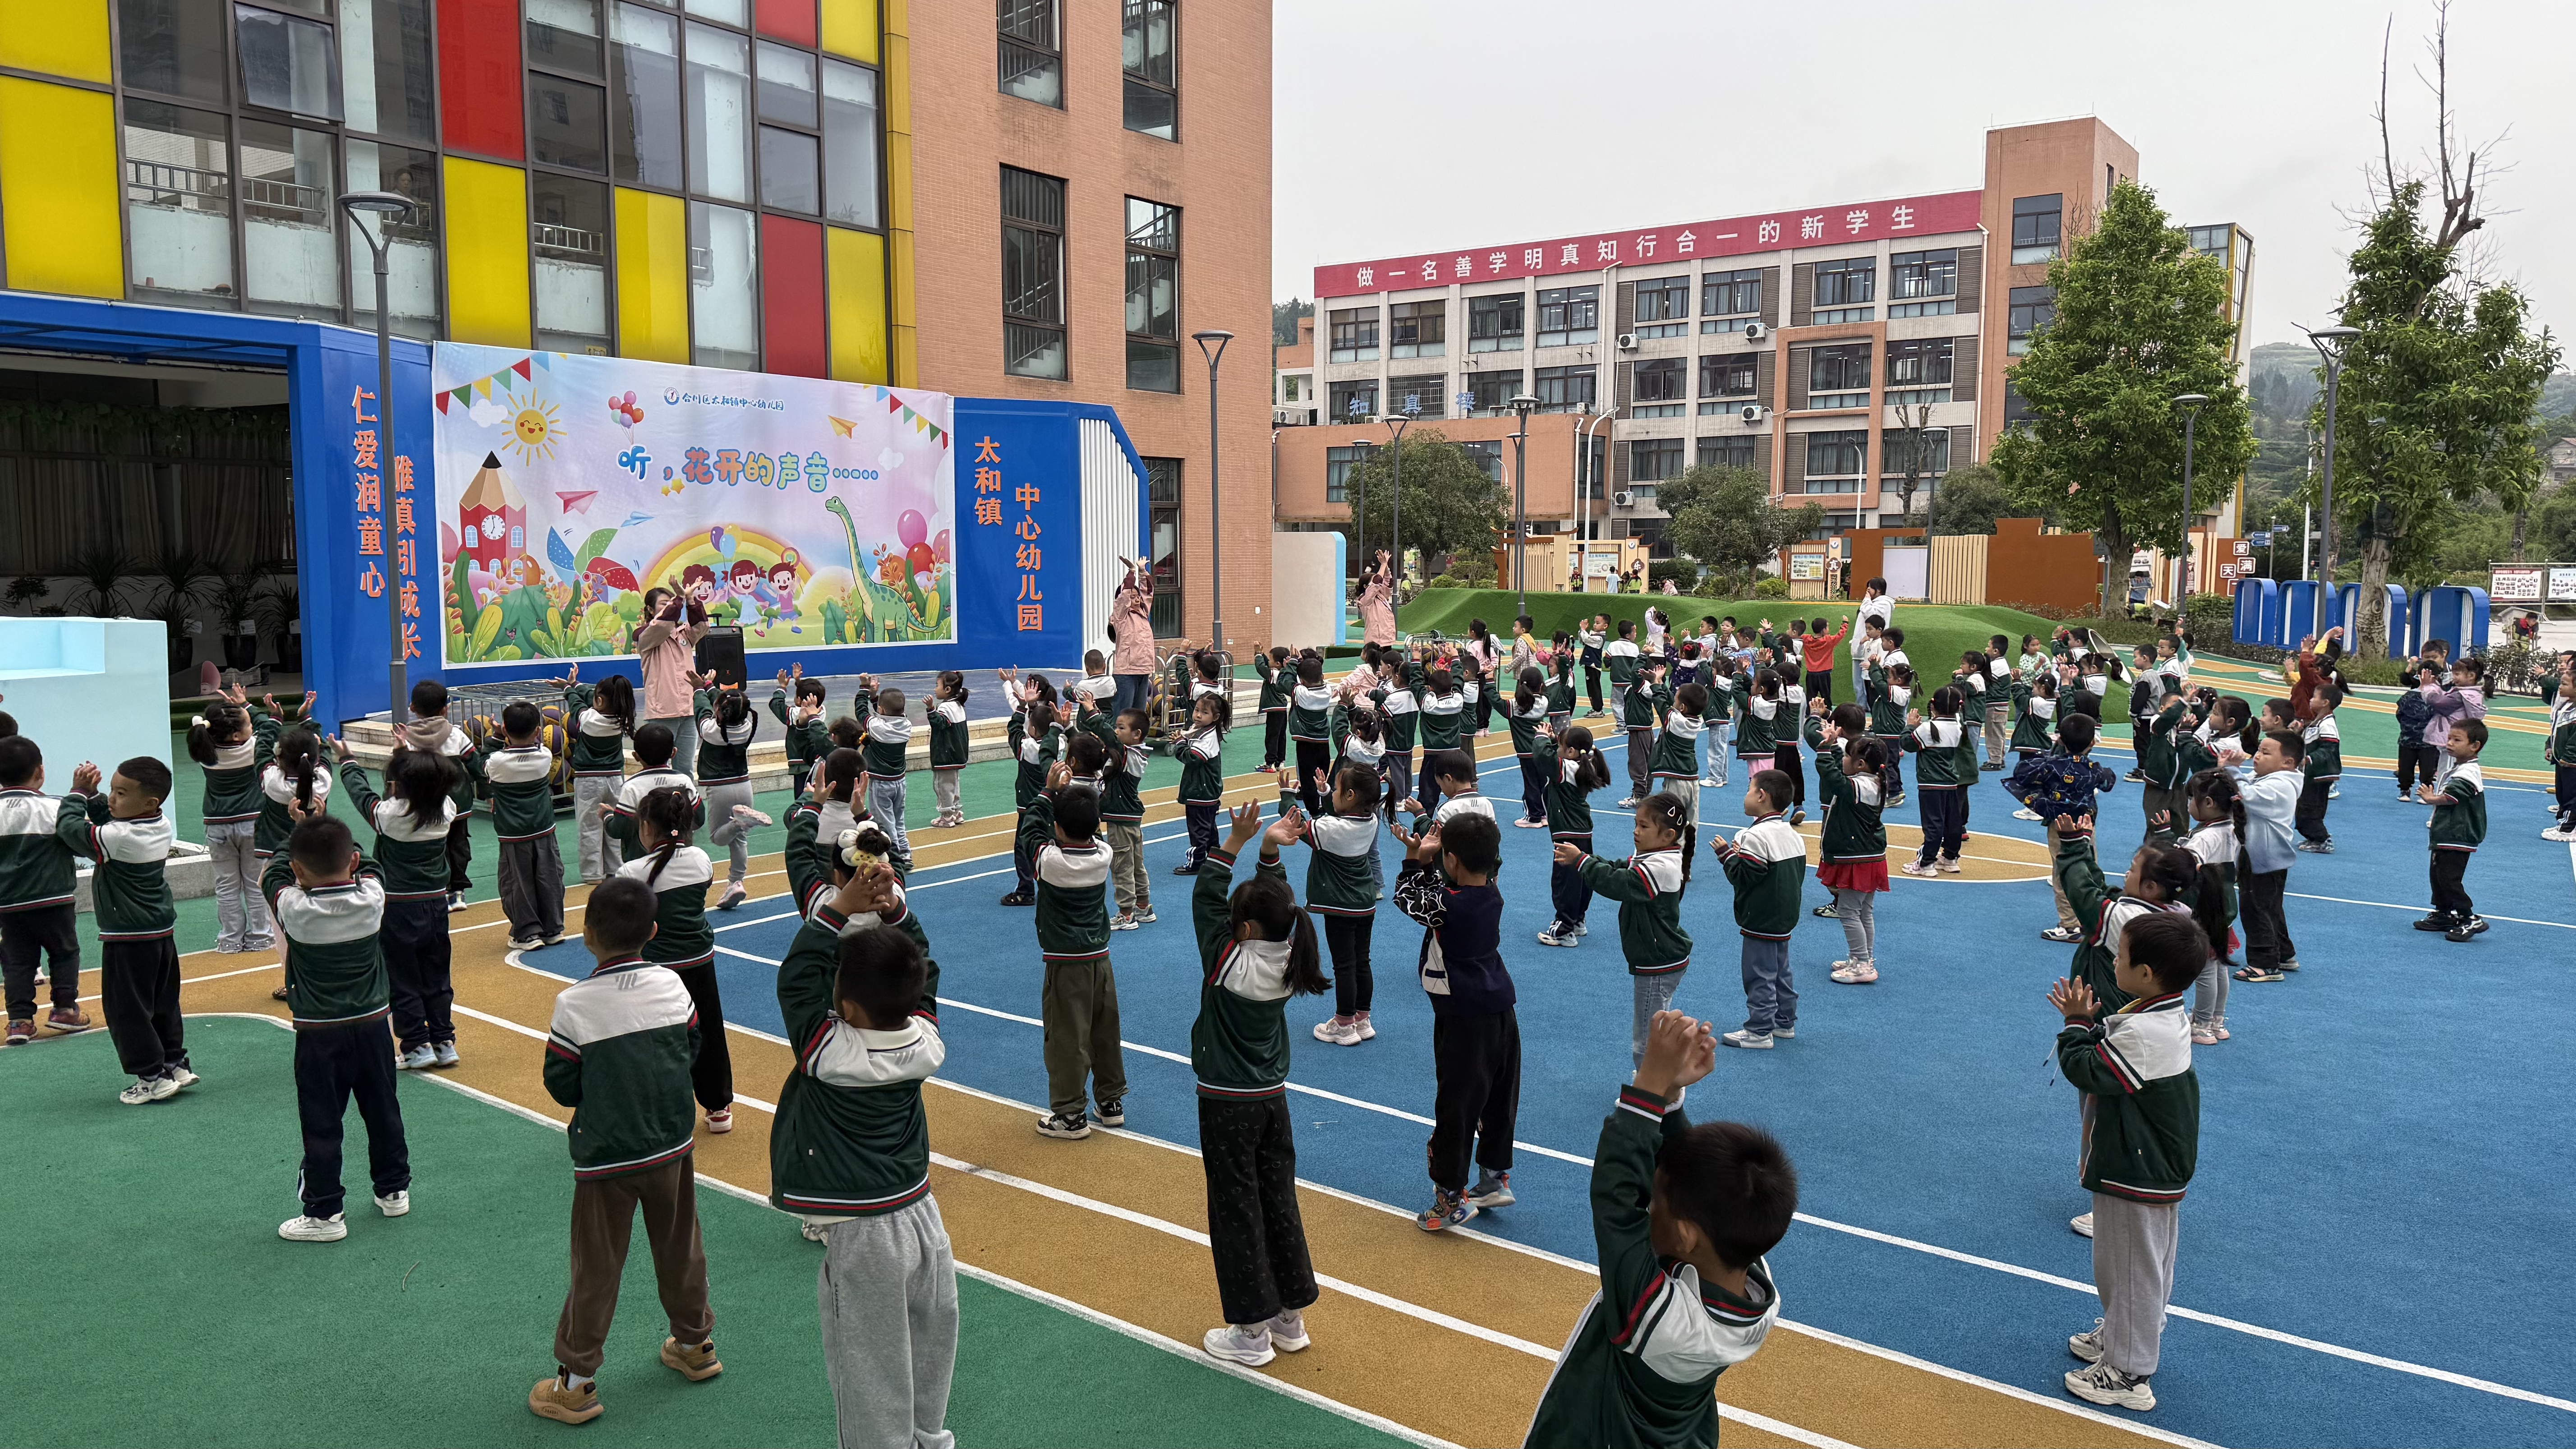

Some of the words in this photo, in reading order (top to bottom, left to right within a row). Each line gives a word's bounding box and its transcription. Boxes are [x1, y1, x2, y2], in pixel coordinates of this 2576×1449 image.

[1357, 205, 1914, 288] 做一名善学明真知行合一的新学生
[682, 392, 784, 410] 合川区太和镇中心幼儿园
[1349, 391, 1476, 417] 知真楼
[352, 385, 385, 598] 仁爱润童心
[975, 436, 1002, 525] 太和镇
[1016, 483, 1043, 631] 中心幼儿园
[1828, 559, 1839, 570] 真
